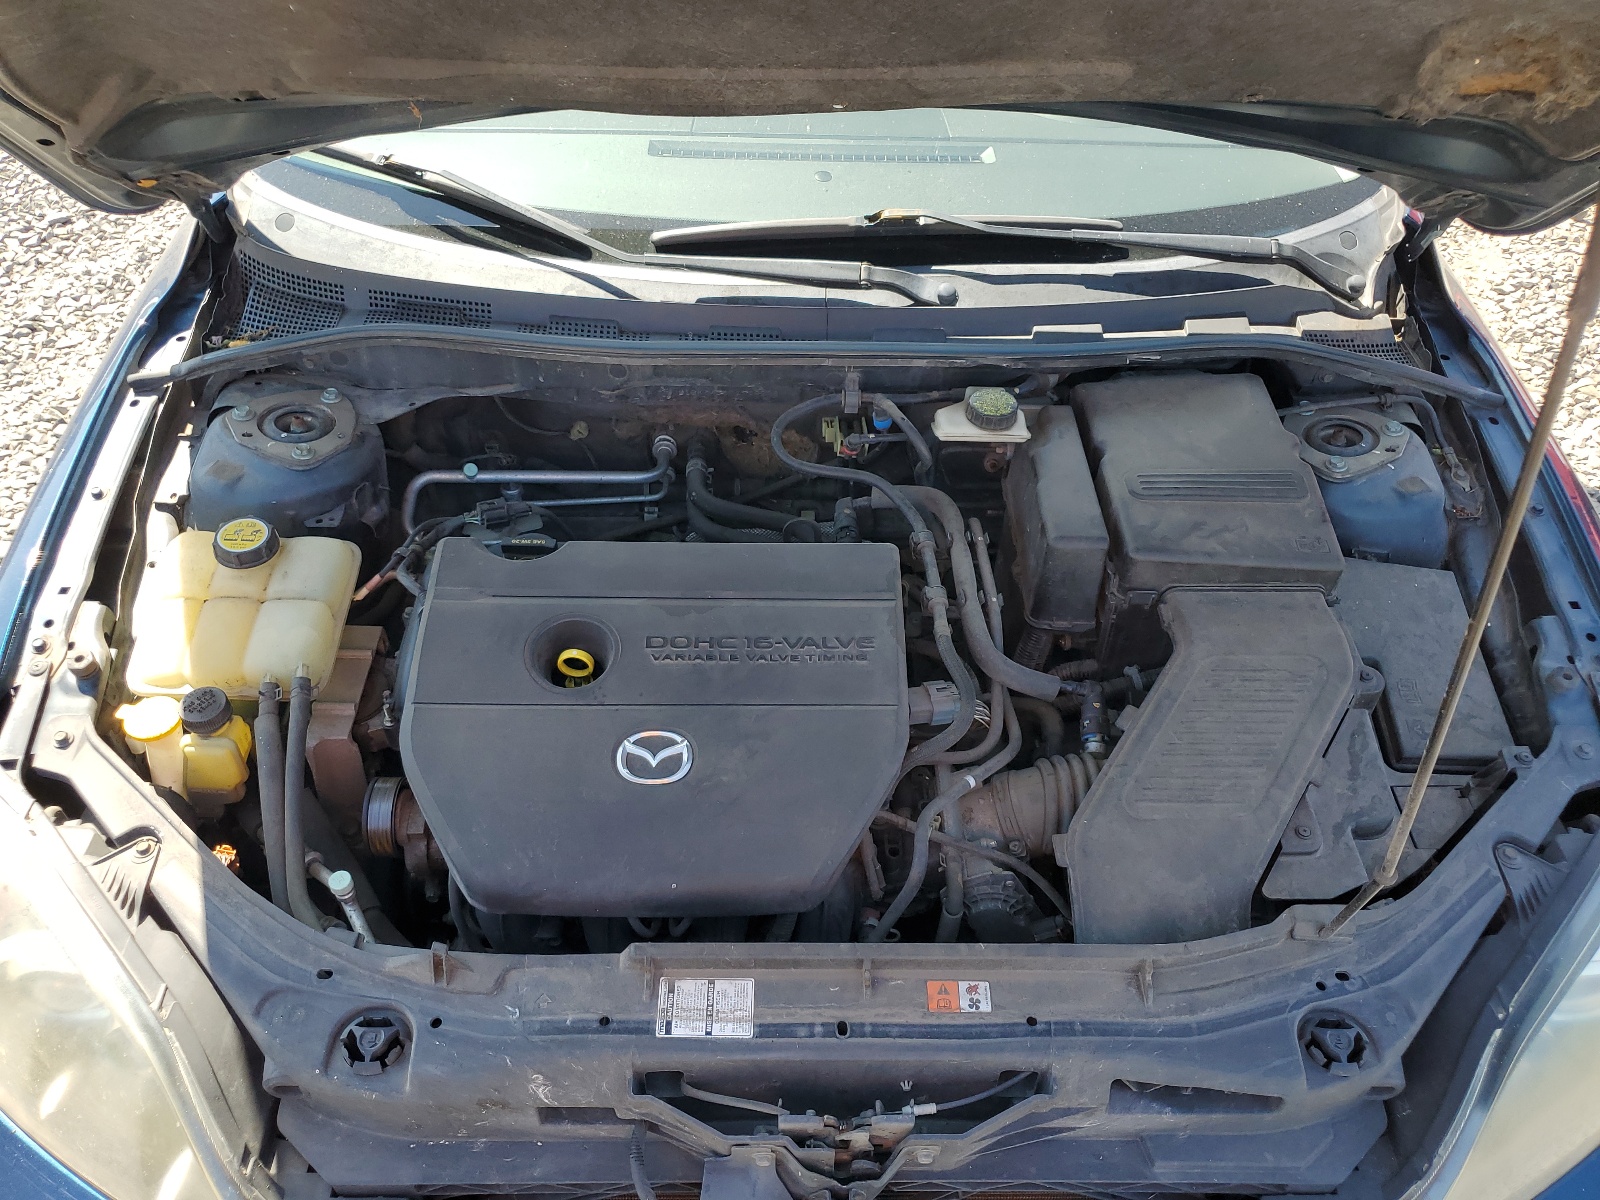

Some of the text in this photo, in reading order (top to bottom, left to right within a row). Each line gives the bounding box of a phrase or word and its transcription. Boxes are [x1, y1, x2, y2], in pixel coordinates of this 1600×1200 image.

[645, 635, 876, 650] DOHC 16-VALVE
[650, 653, 869, 662] VARIABLE VALVE TIMING
[666, 992, 674, 1021] CAUTION
[707, 1006, 713, 1015] EN
